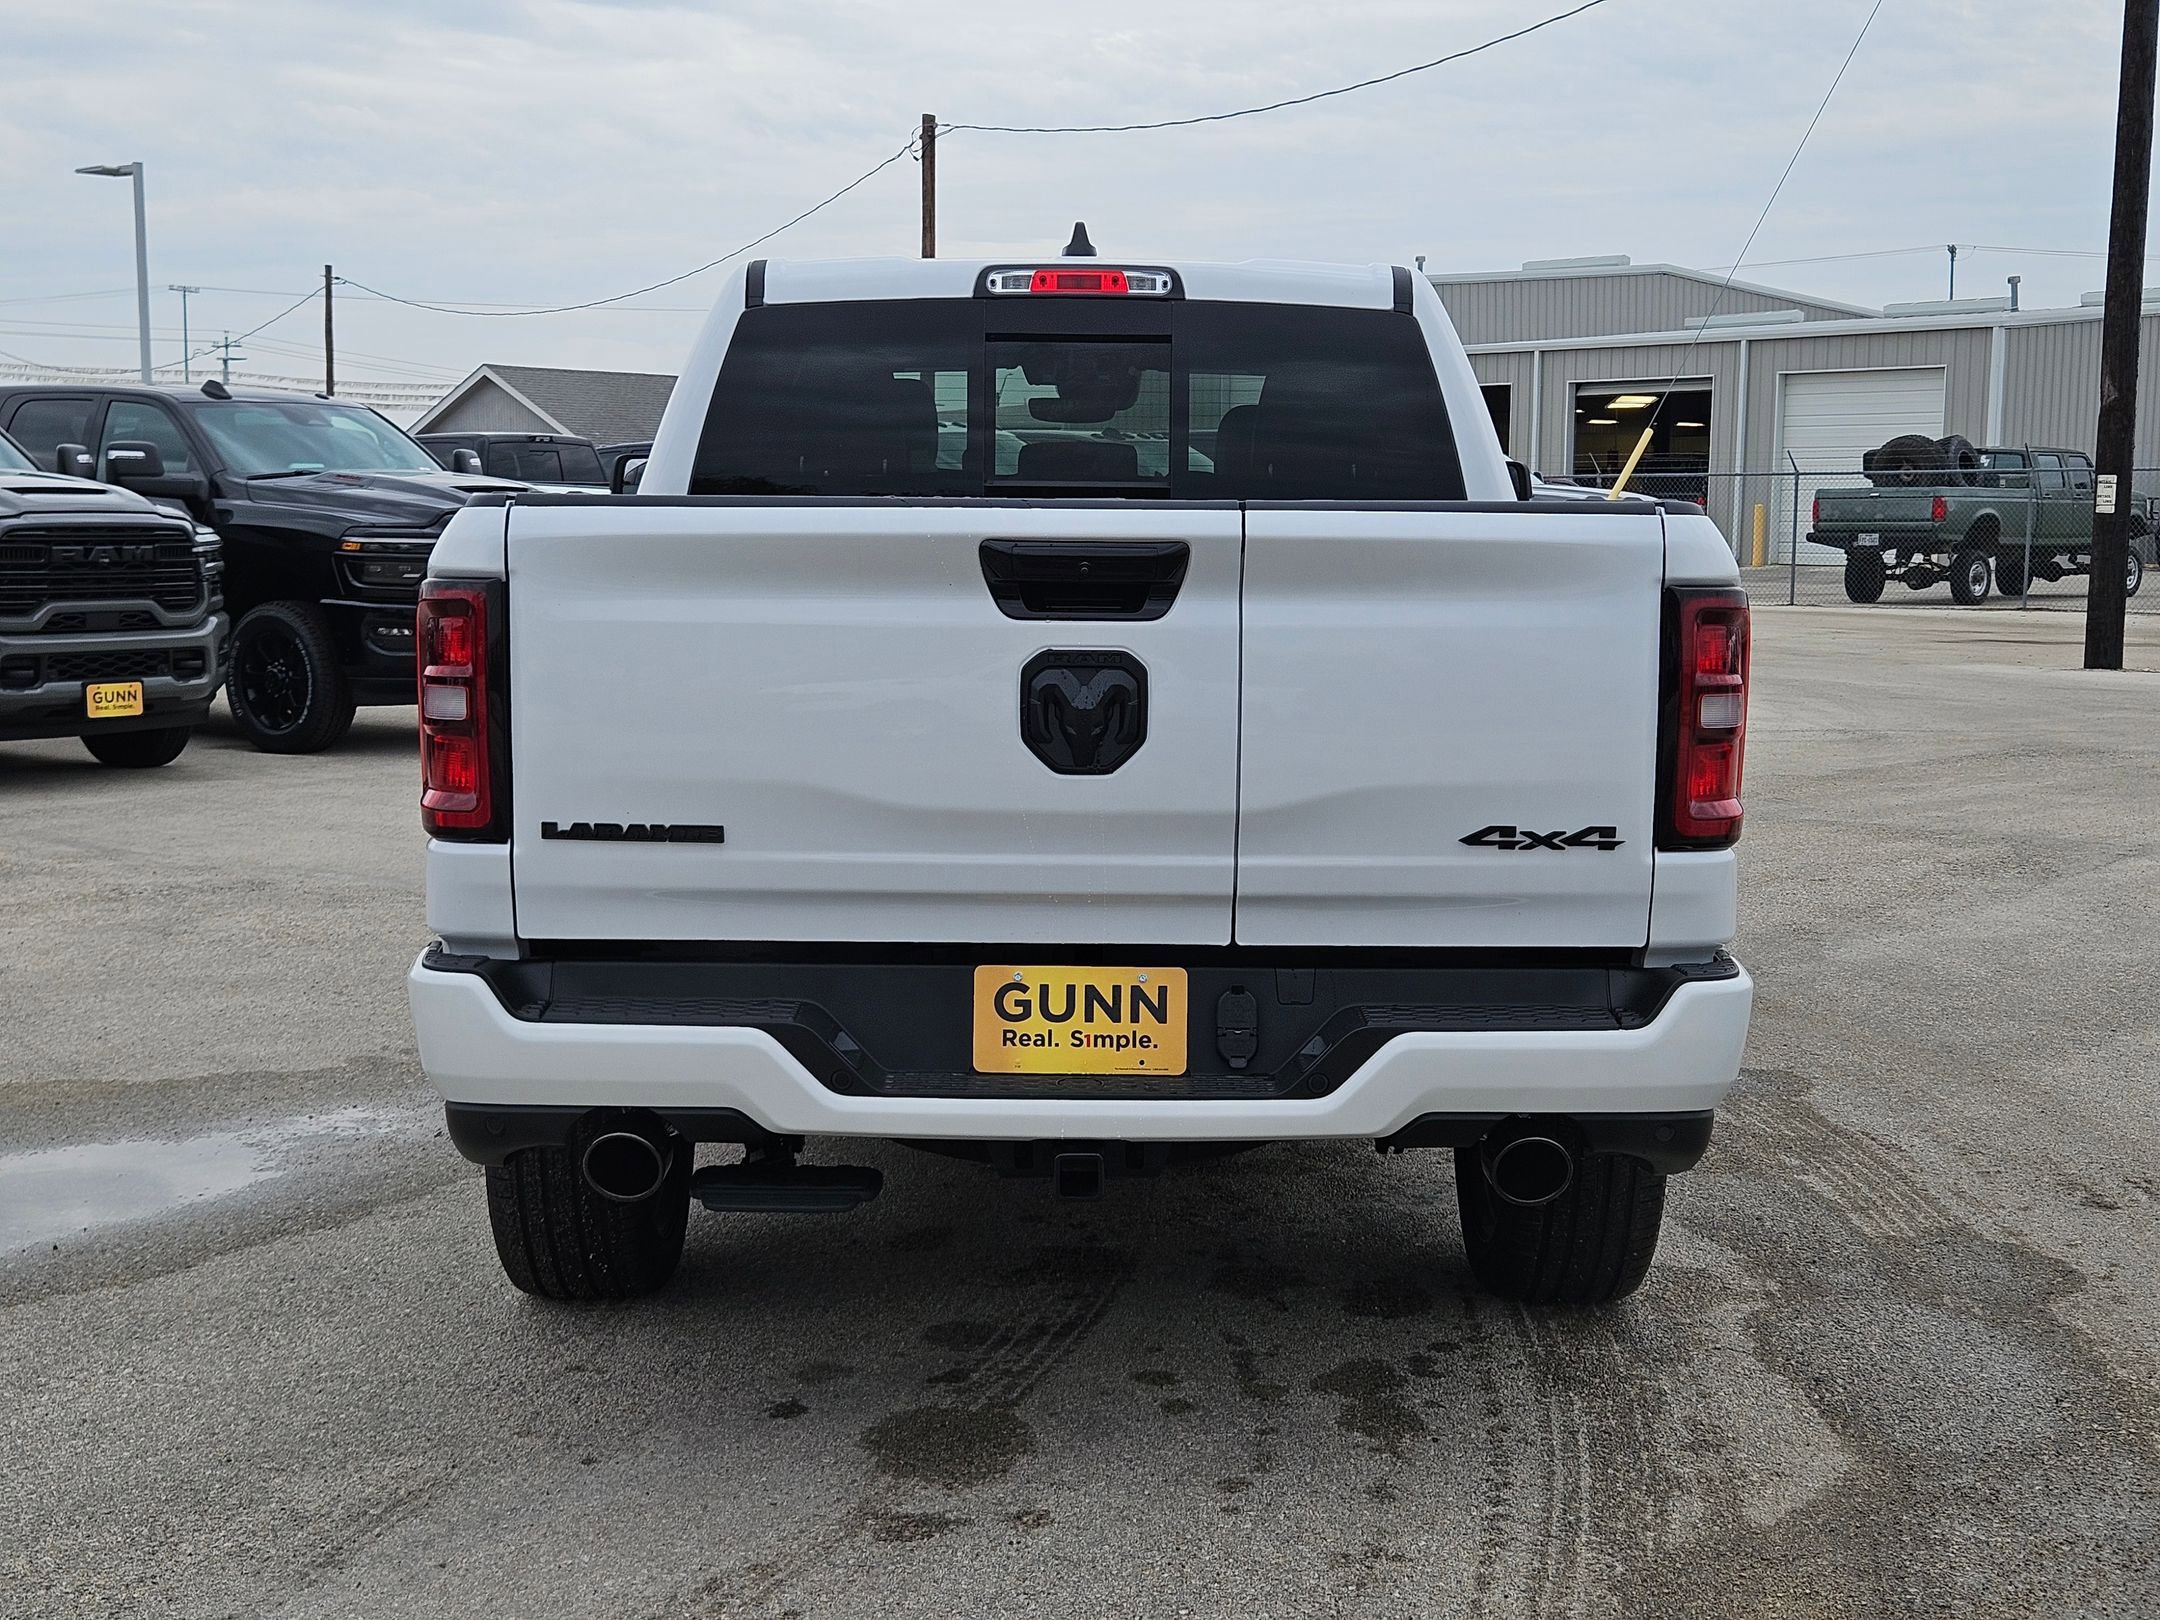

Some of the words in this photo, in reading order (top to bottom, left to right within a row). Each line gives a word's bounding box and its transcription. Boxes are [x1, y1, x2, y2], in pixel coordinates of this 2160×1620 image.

[51, 545, 155, 563] RAM
[1047, 652, 1122, 665] RAM
[92, 690, 137, 704] GUNN
[541, 821, 725, 843] LARAMIE
[1457, 825, 1626, 851] 4x4
[993, 981, 1168, 1025] GUNN
[1002, 1029, 1060, 1048] Real.
